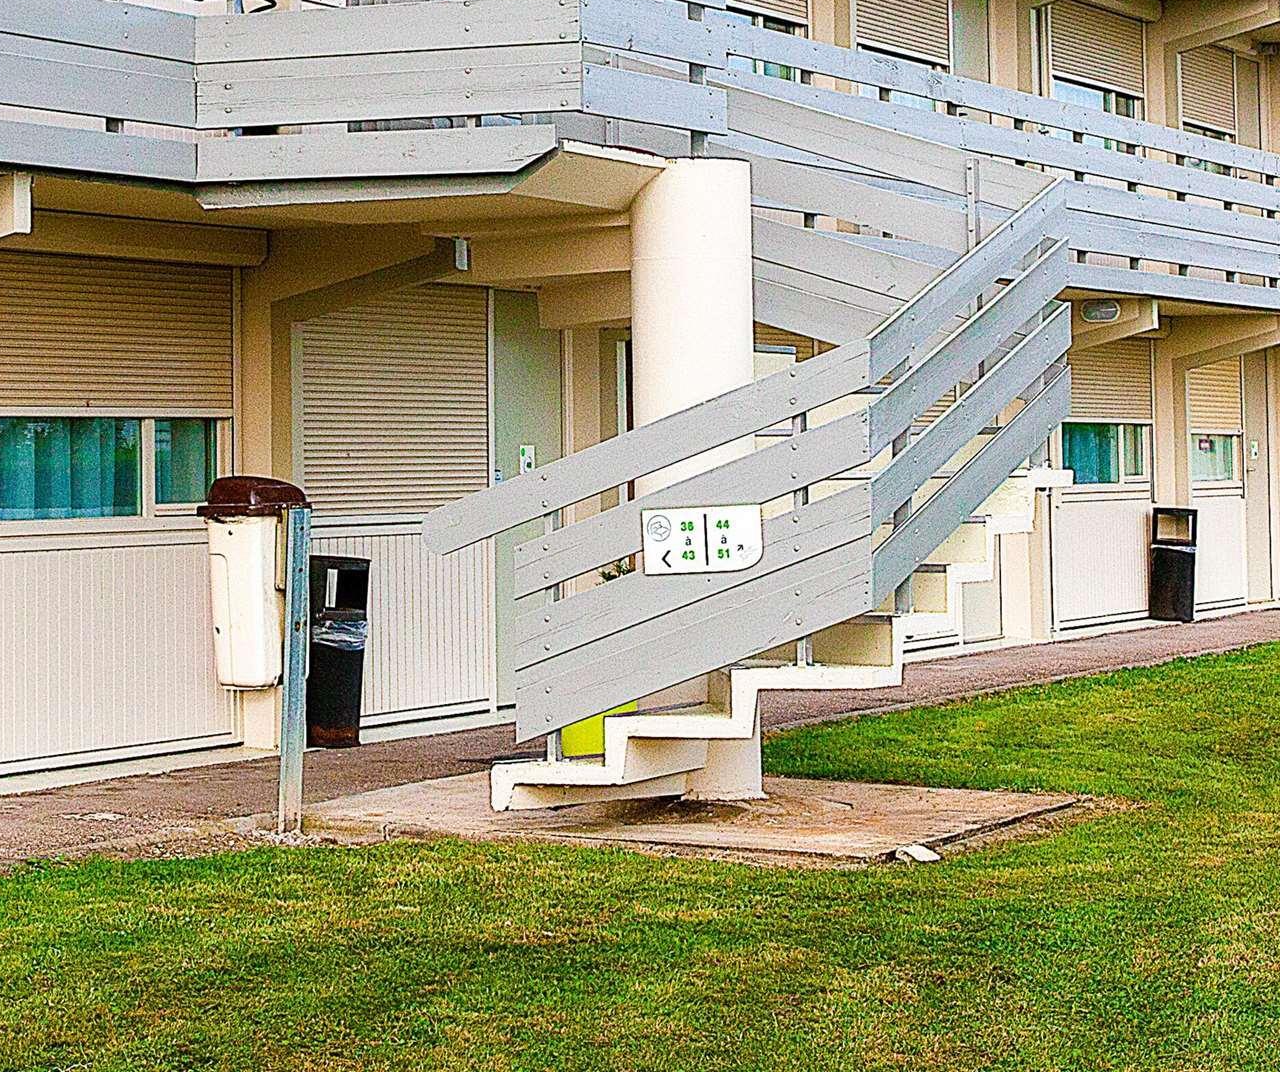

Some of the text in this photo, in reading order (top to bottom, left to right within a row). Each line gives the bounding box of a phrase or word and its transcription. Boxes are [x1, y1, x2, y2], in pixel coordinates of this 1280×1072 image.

[716, 519, 730, 529] 44
[685, 535, 692, 546] à
[682, 550, 695, 560] 43
[717, 548, 730, 559] 51
